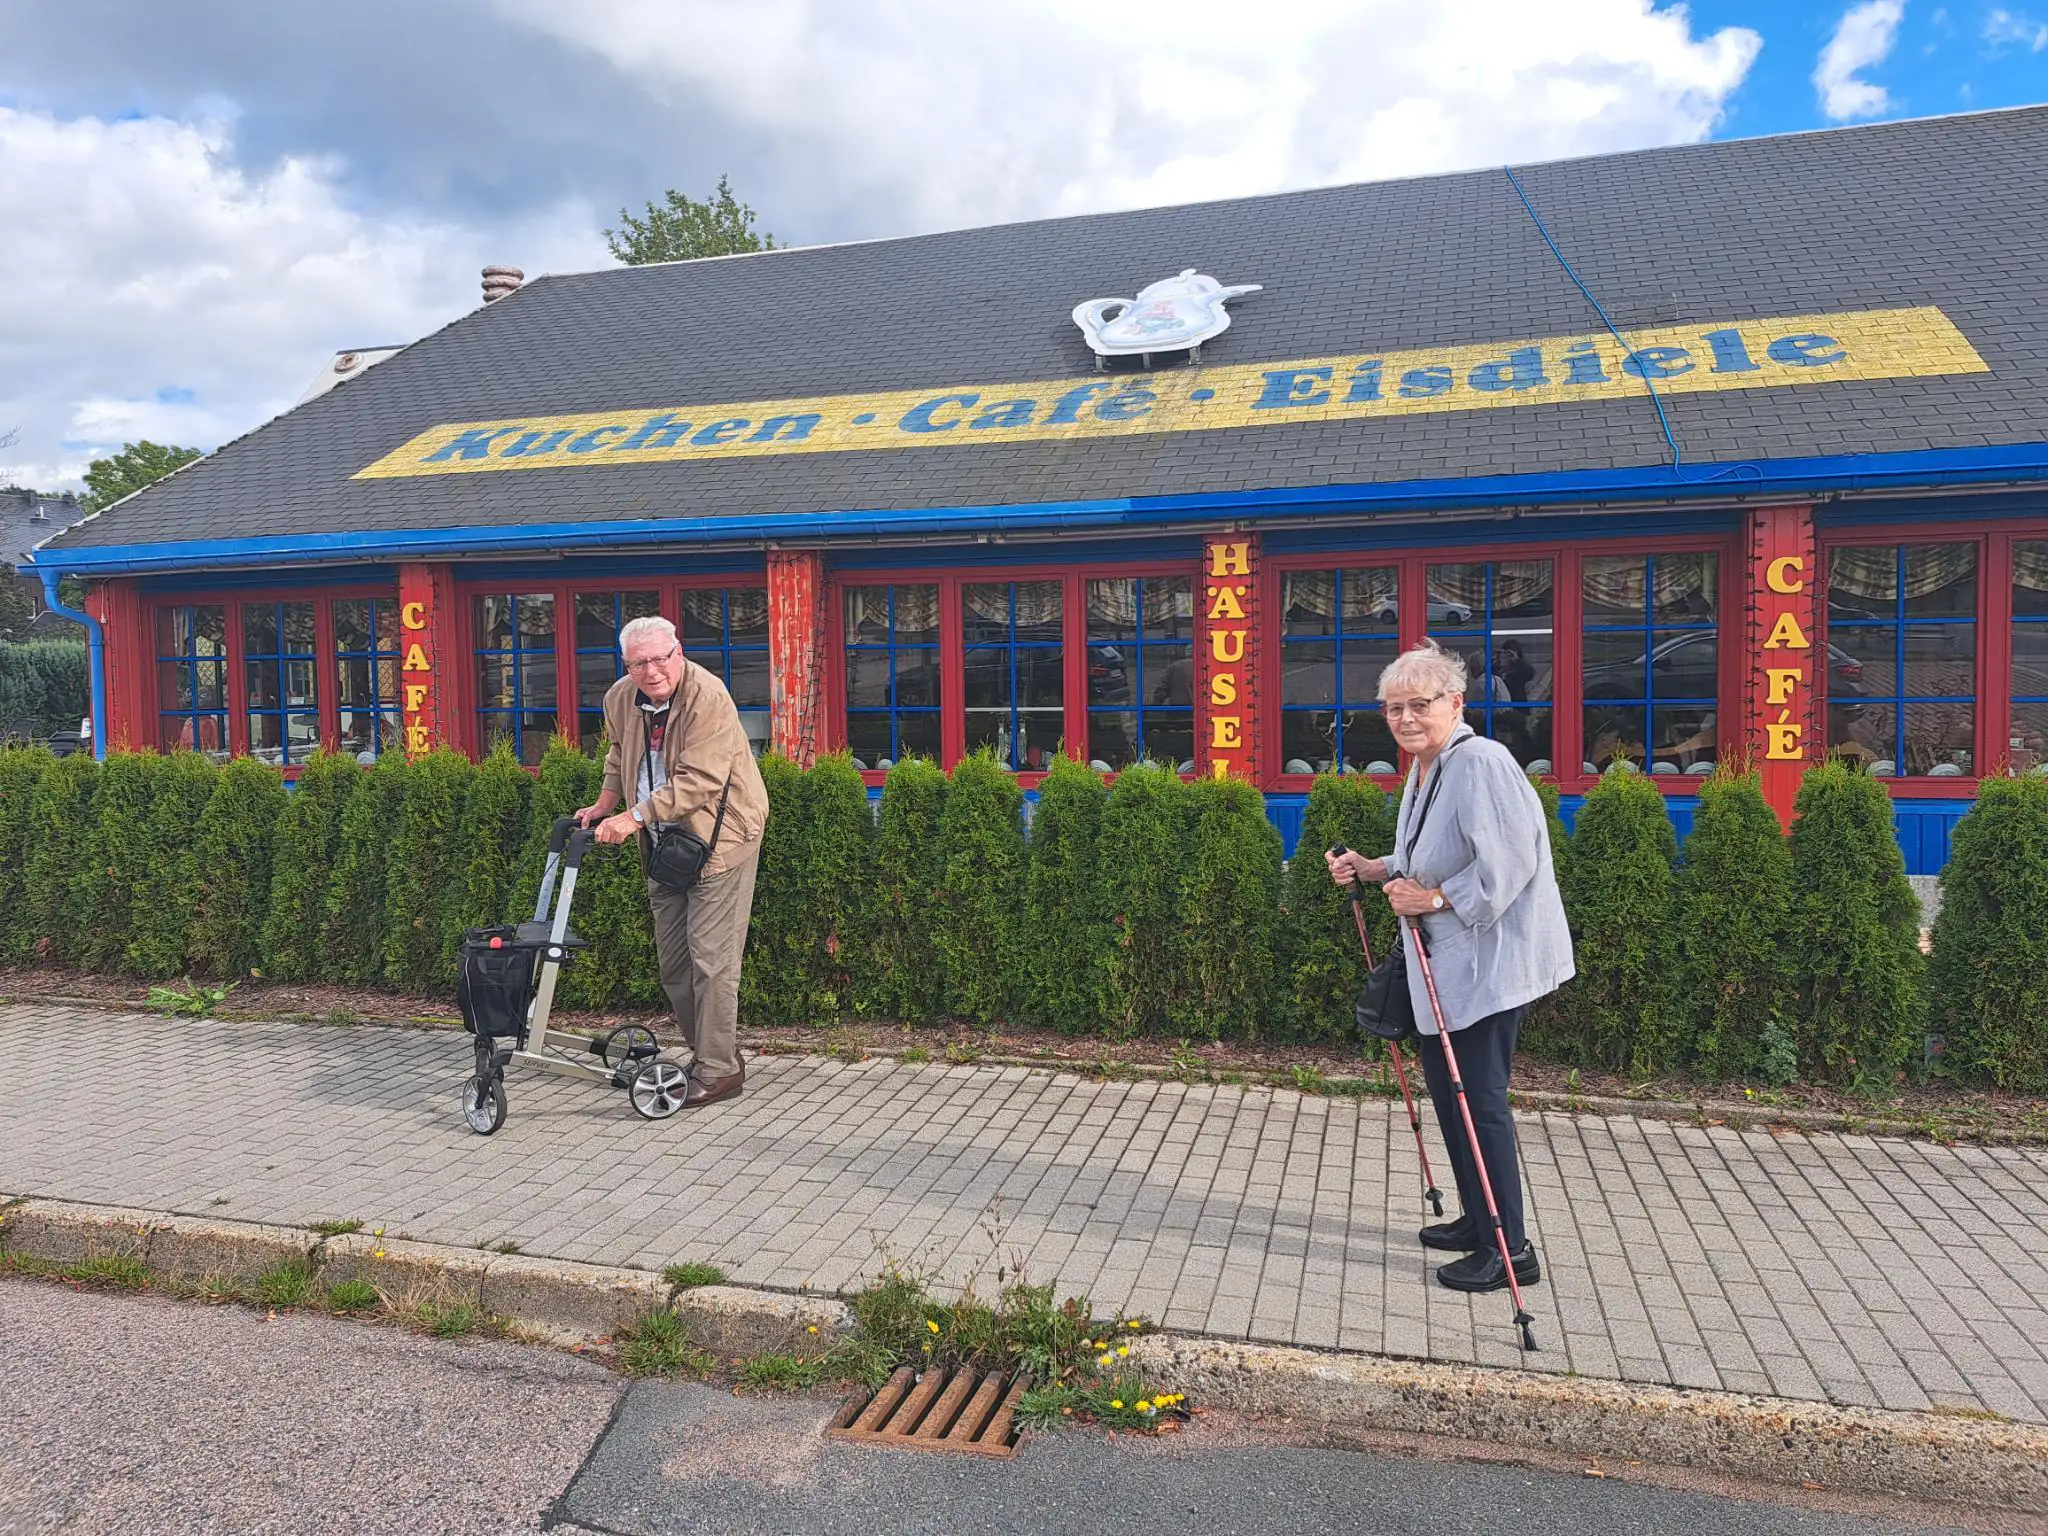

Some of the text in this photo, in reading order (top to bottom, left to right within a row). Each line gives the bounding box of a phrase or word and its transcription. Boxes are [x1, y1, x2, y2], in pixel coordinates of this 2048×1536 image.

[420, 328, 1847, 462] Kuchen Café Eisdiele
[402, 602, 431, 754] CAFÉ
[1763, 556, 1810, 760] CAFÉ
